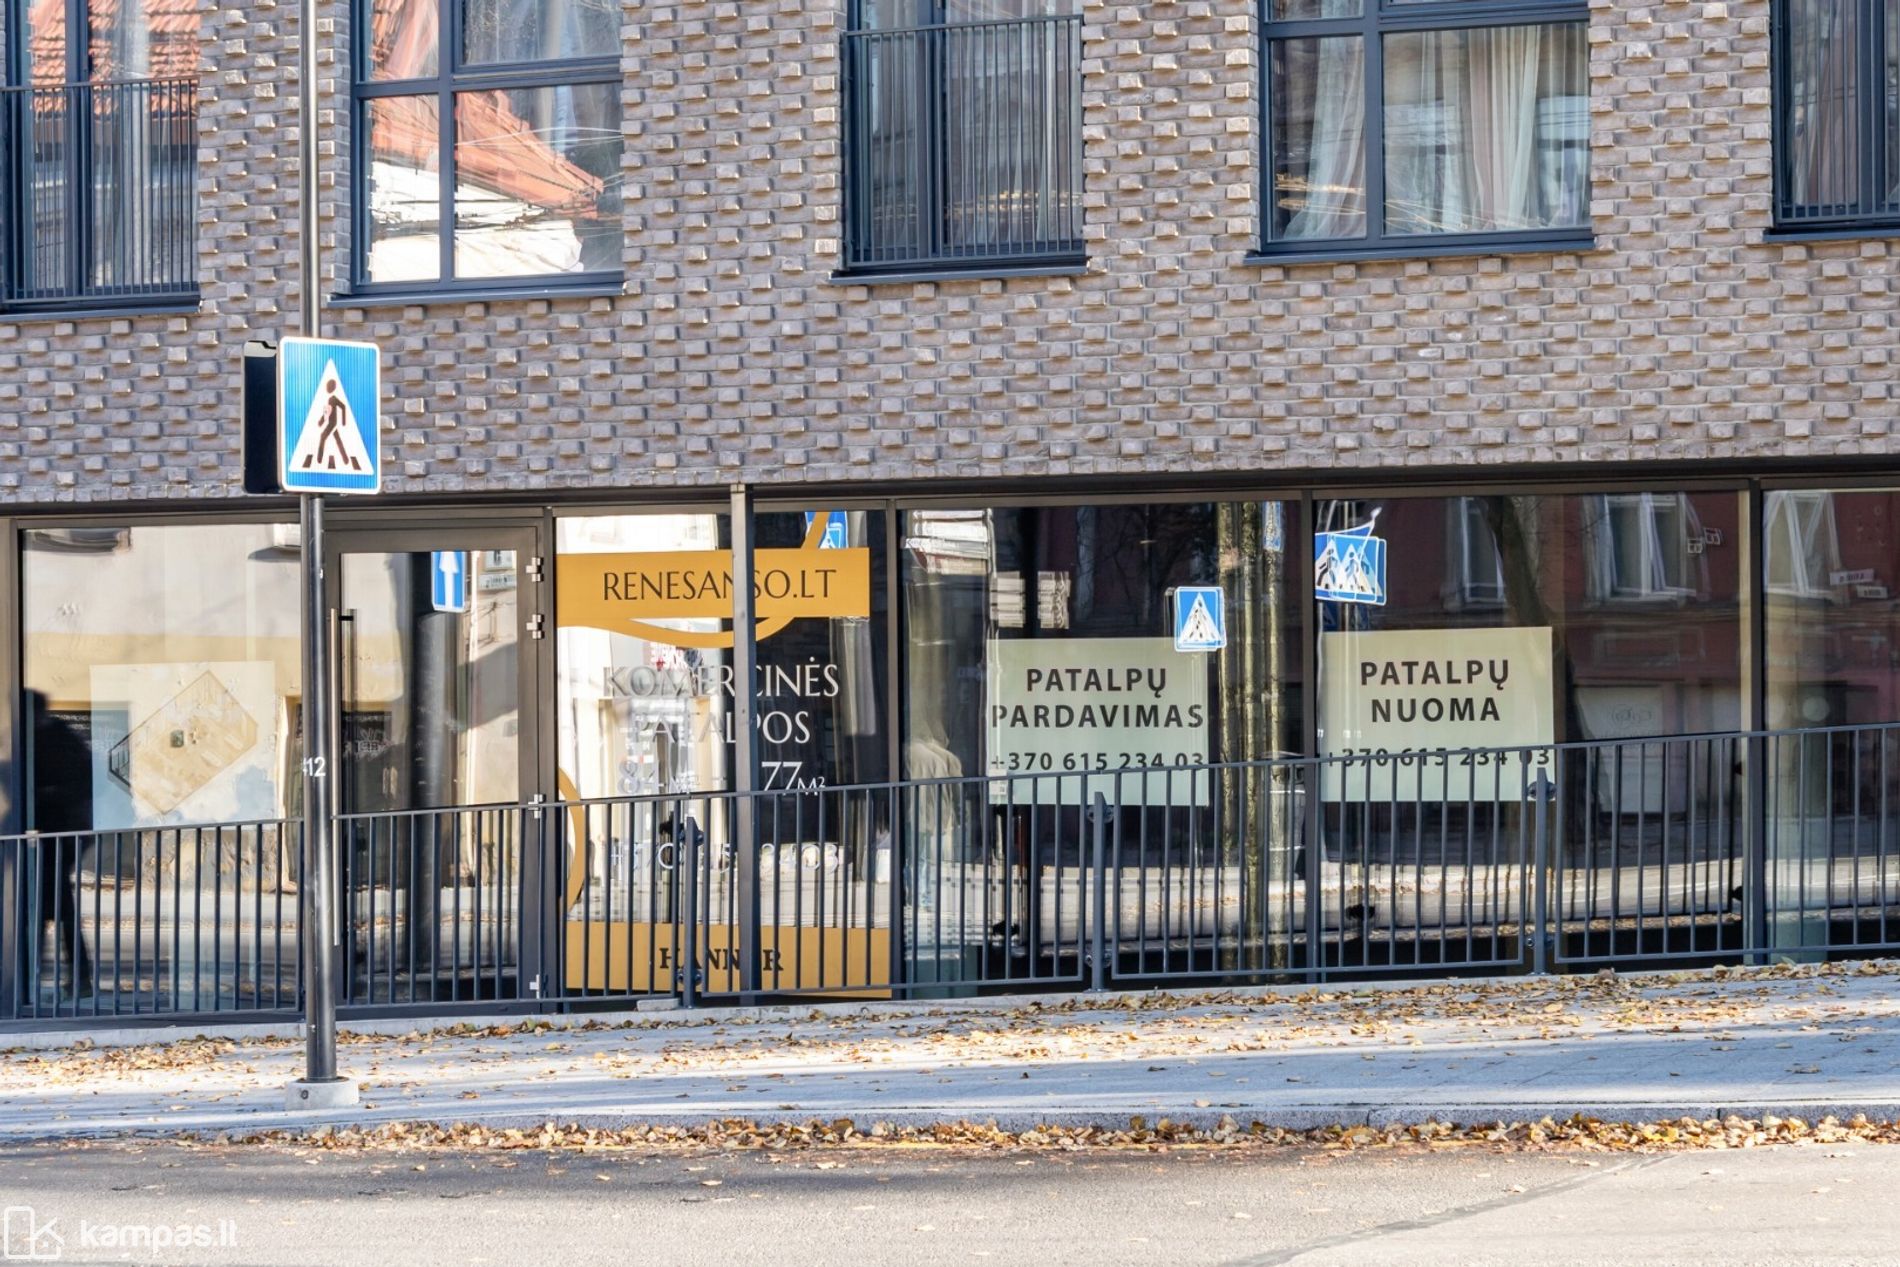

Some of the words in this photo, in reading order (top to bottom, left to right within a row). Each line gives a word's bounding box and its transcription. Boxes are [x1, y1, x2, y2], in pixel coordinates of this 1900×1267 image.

[603, 656, 840, 698] KOMERINĖS
[1026, 668, 1167, 699] PATALPŲ
[1360, 659, 1509, 690] PATALPŲ
[991, 704, 1204, 729] PARDAVIMAS
[1371, 697, 1501, 723] NUOMA
[634, 710, 811, 745] PATALOS
[991, 752, 1053, 771] +370
[1063, 752, 1108, 771] 615
[1119, 752, 1164, 770] 234
[1174, 752, 1204, 770] 03
[659, 946, 785, 972] HNNR
